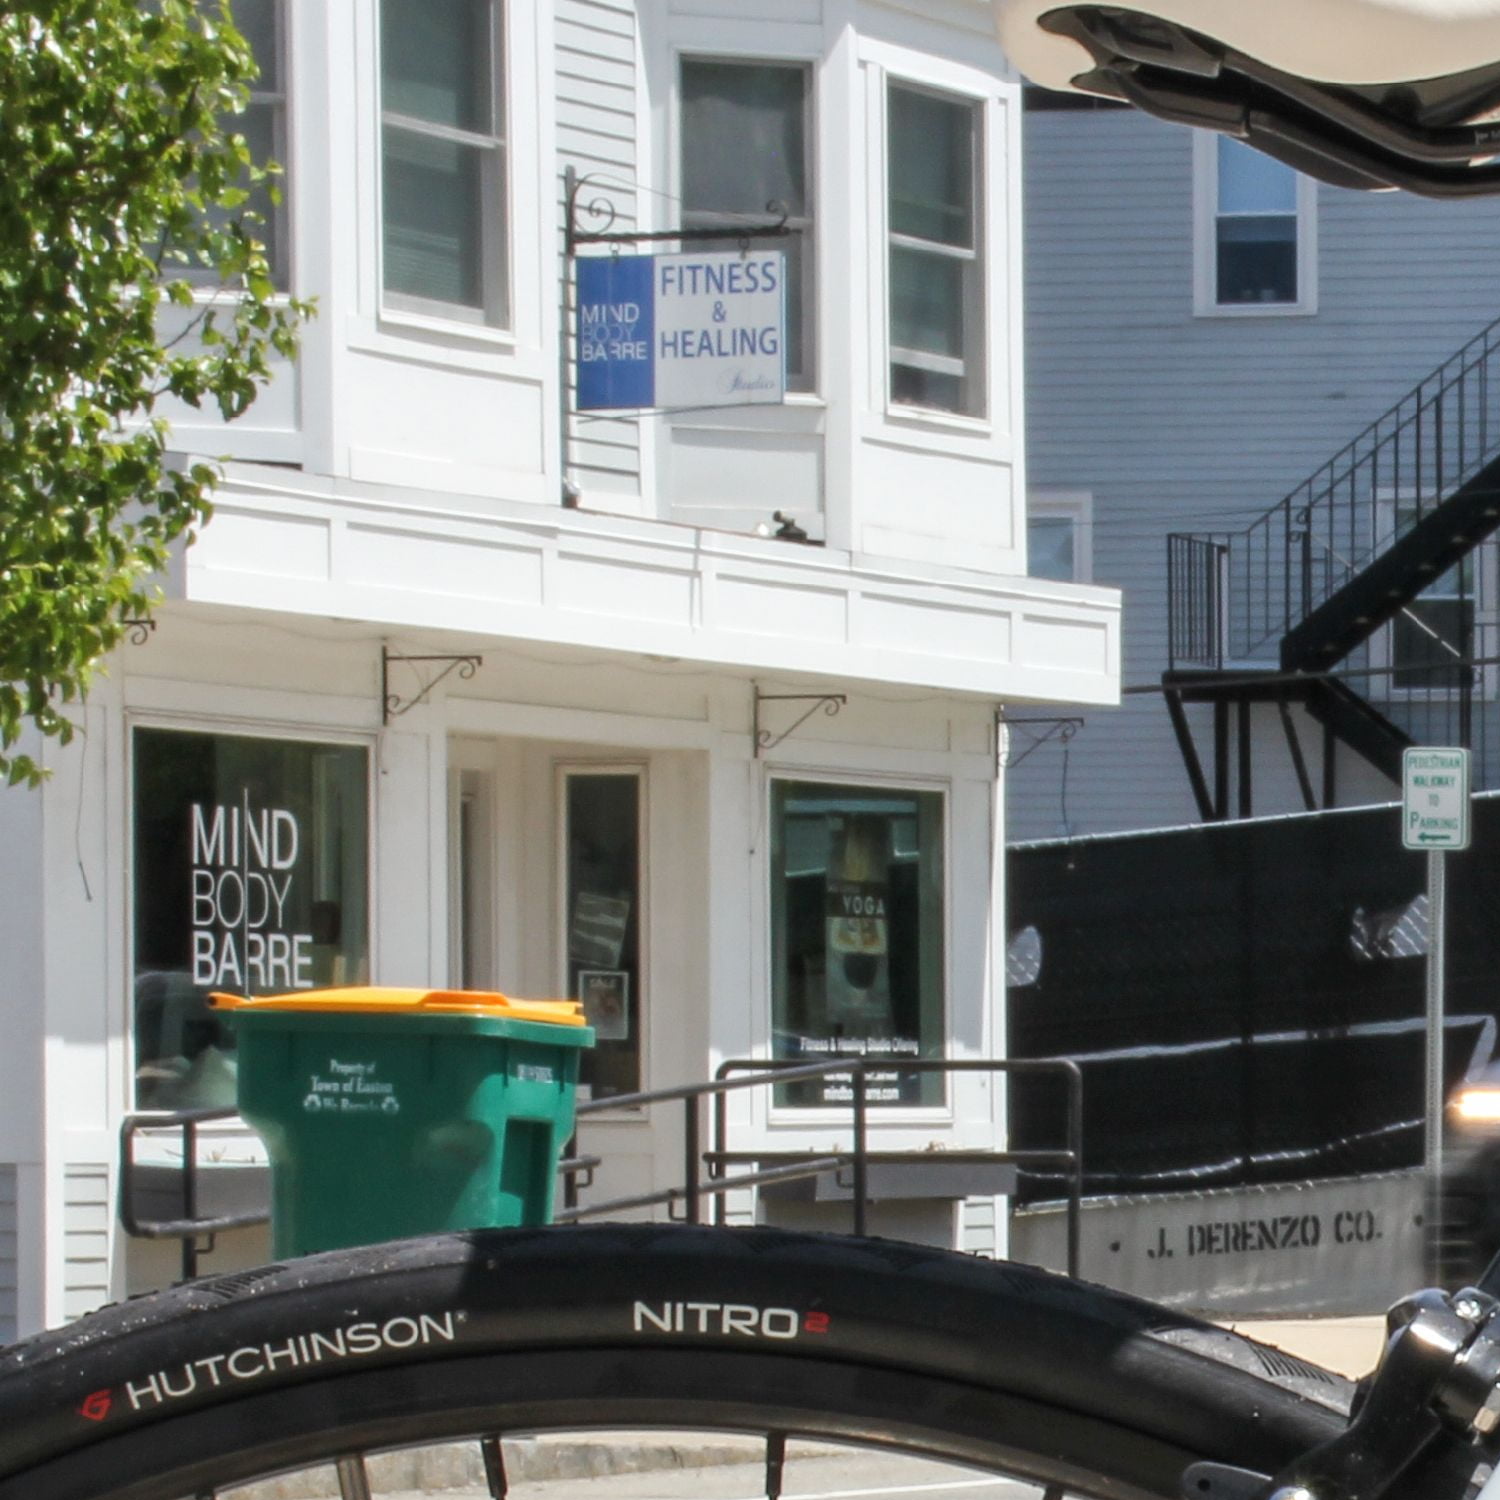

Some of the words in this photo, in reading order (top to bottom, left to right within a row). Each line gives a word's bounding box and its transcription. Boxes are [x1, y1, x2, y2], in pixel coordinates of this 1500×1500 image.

[660, 261, 777, 296] FITNESS
[581, 302, 640, 324] MIND
[711, 300, 727, 323] &
[581, 323, 636, 344] BODY
[660, 326, 778, 359] HEALING
[581, 341, 648, 362] BARRE
[1408, 756, 1461, 769] PEDESTRIAN
[1413, 776, 1456, 787] WALKWAY
[1410, 811, 1458, 829] PARKING
[192, 803, 299, 870] MIND
[192, 869, 293, 929] BODY
[842, 896, 886, 916] YOGA
[192, 930, 314, 988] BARRE
[311, 1076, 340, 1092] Town
[342, 1077, 355, 1092] of
[1147, 1227, 1173, 1258] J.
[1187, 1213, 1321, 1257] DERENZO
[1333, 1210, 1383, 1244] CO.
[126, 1310, 456, 1411] HUTCHINSON
